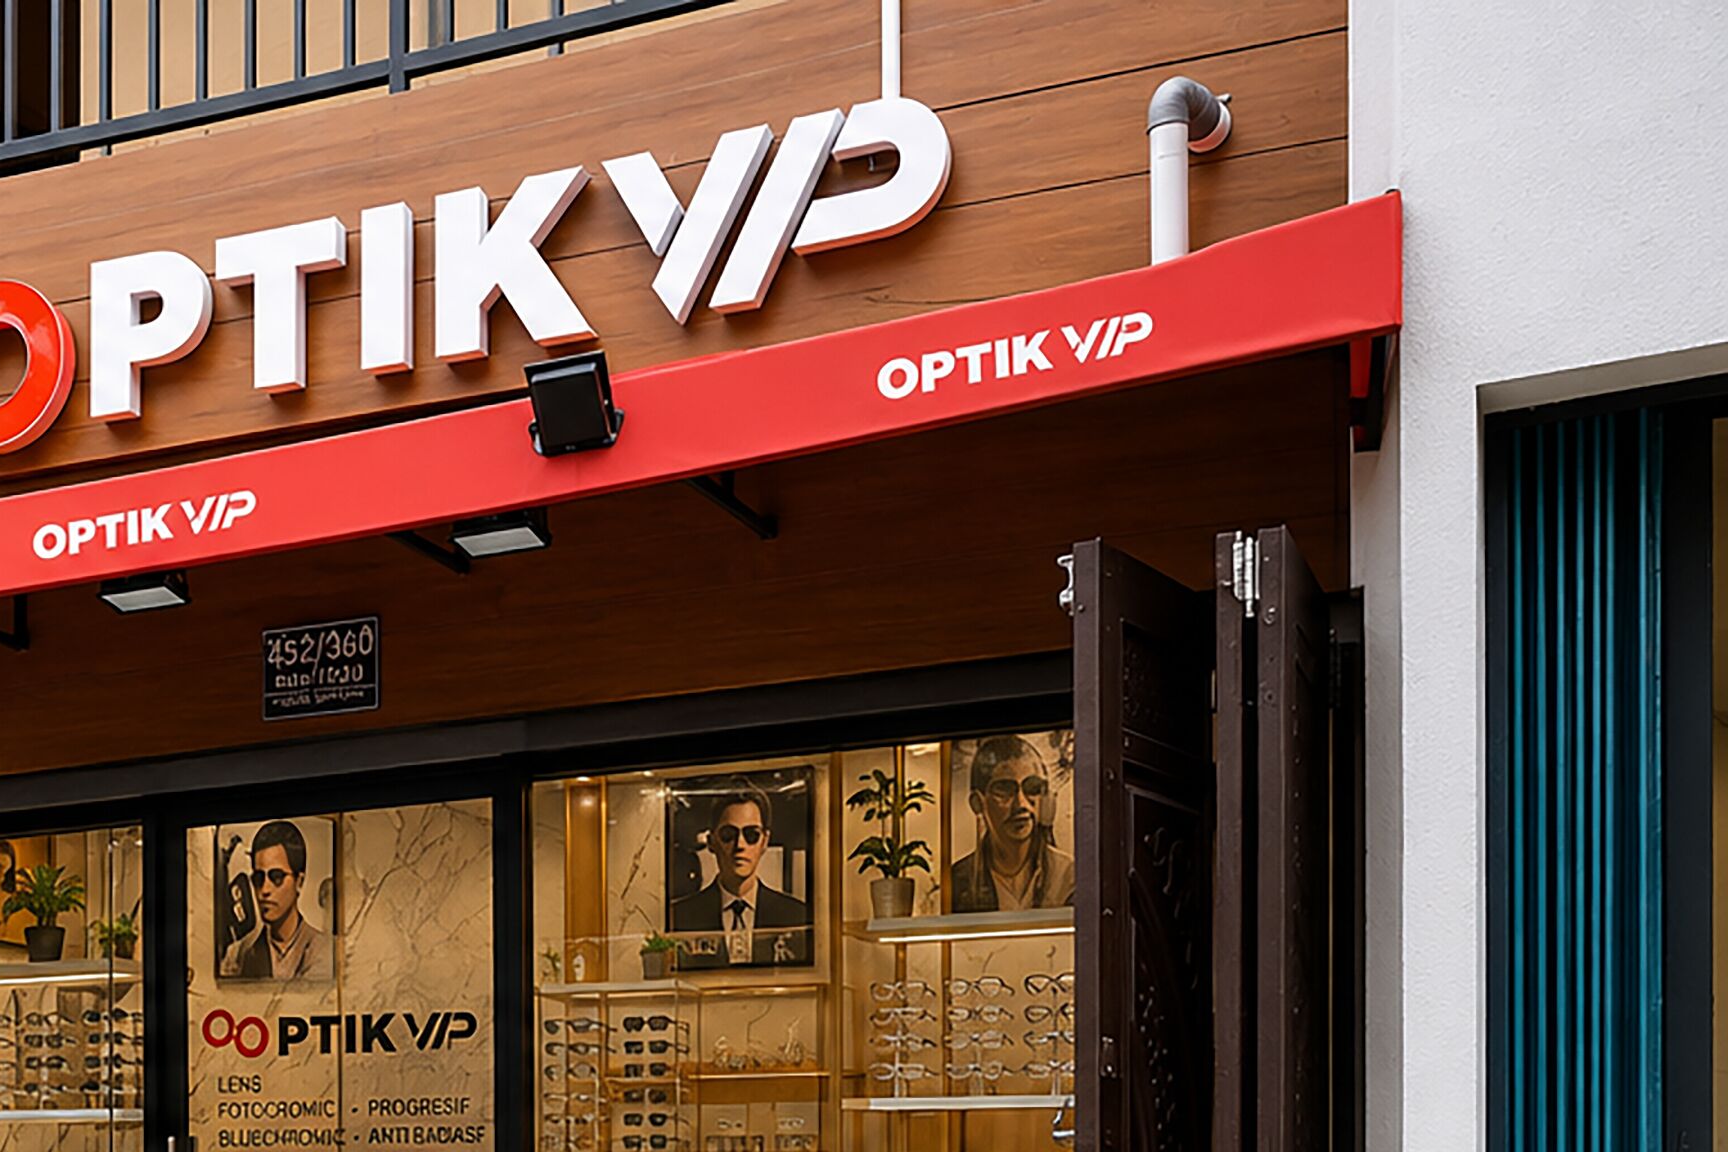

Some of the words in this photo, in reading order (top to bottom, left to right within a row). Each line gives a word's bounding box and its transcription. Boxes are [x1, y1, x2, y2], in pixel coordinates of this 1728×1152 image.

[602, 97, 953, 324] VIP
[877, 330, 1053, 399] OPTIK
[1061, 312, 1153, 363] VIP
[32, 503, 173, 559] OPTIK
[180, 490, 256, 534] VIP
[403, 1012, 477, 1050] VIP
[218, 1075, 261, 1093] LENS
[368, 1097, 471, 1116] PROGRESIF
[368, 1126, 409, 1145] ANTI
